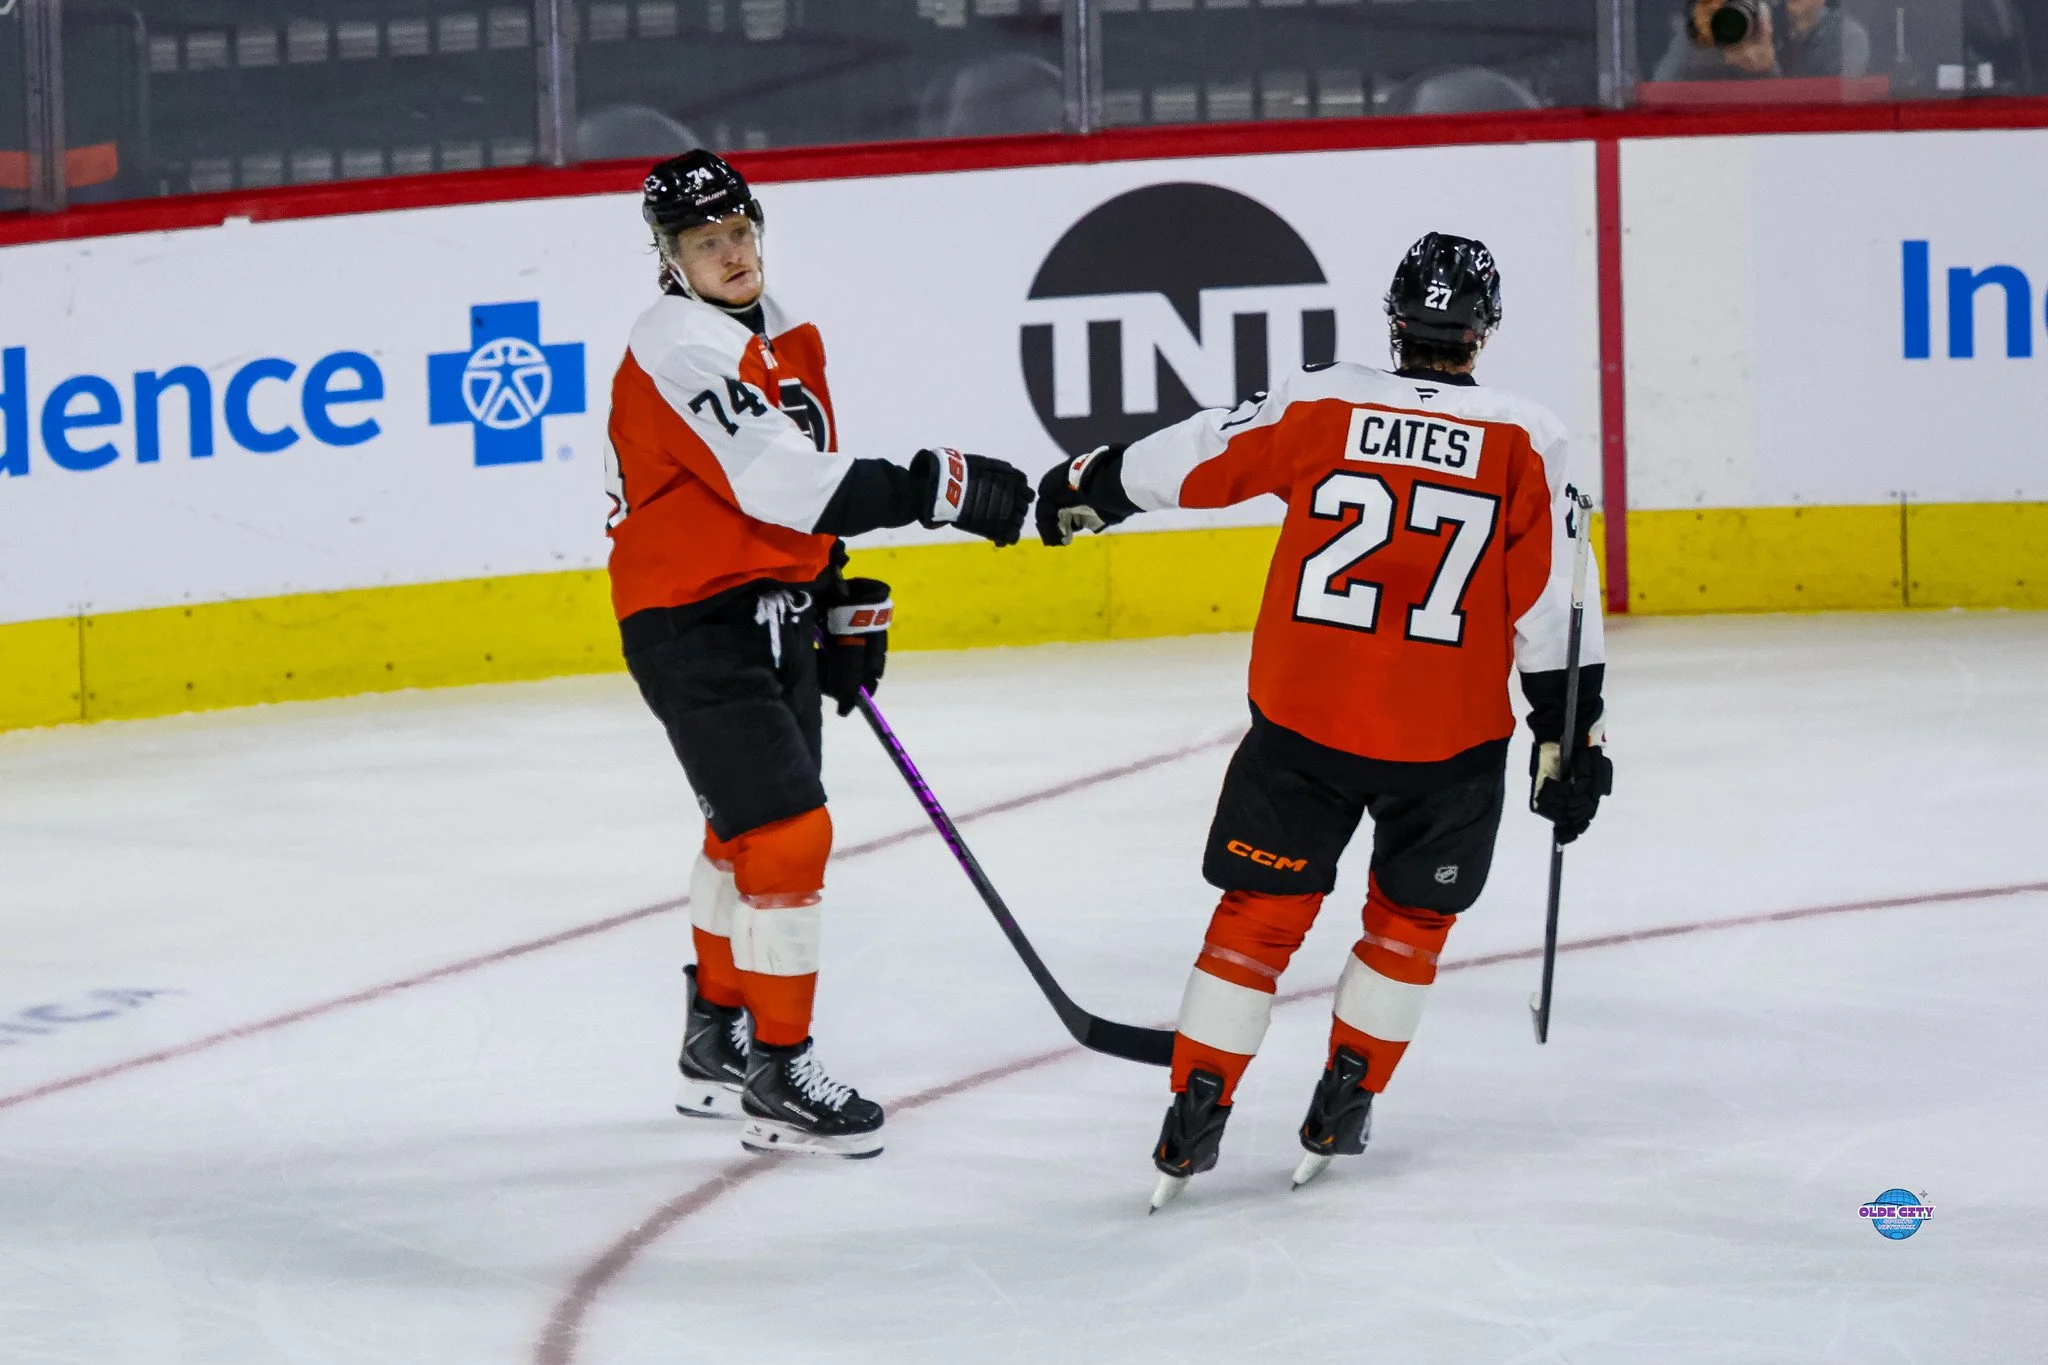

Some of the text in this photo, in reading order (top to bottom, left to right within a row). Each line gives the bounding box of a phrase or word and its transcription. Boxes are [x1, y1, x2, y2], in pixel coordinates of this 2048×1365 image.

[686, 167, 714, 187] 74
[1424, 285, 1453, 312] 27
[1902, 239, 2048, 359] In
[1021, 282, 1336, 418] TNT
[687, 375, 768, 437] 74
[1359, 416, 1470, 468] CATES
[1291, 468, 1502, 648] 27
[1226, 838, 1308, 872] CCM
